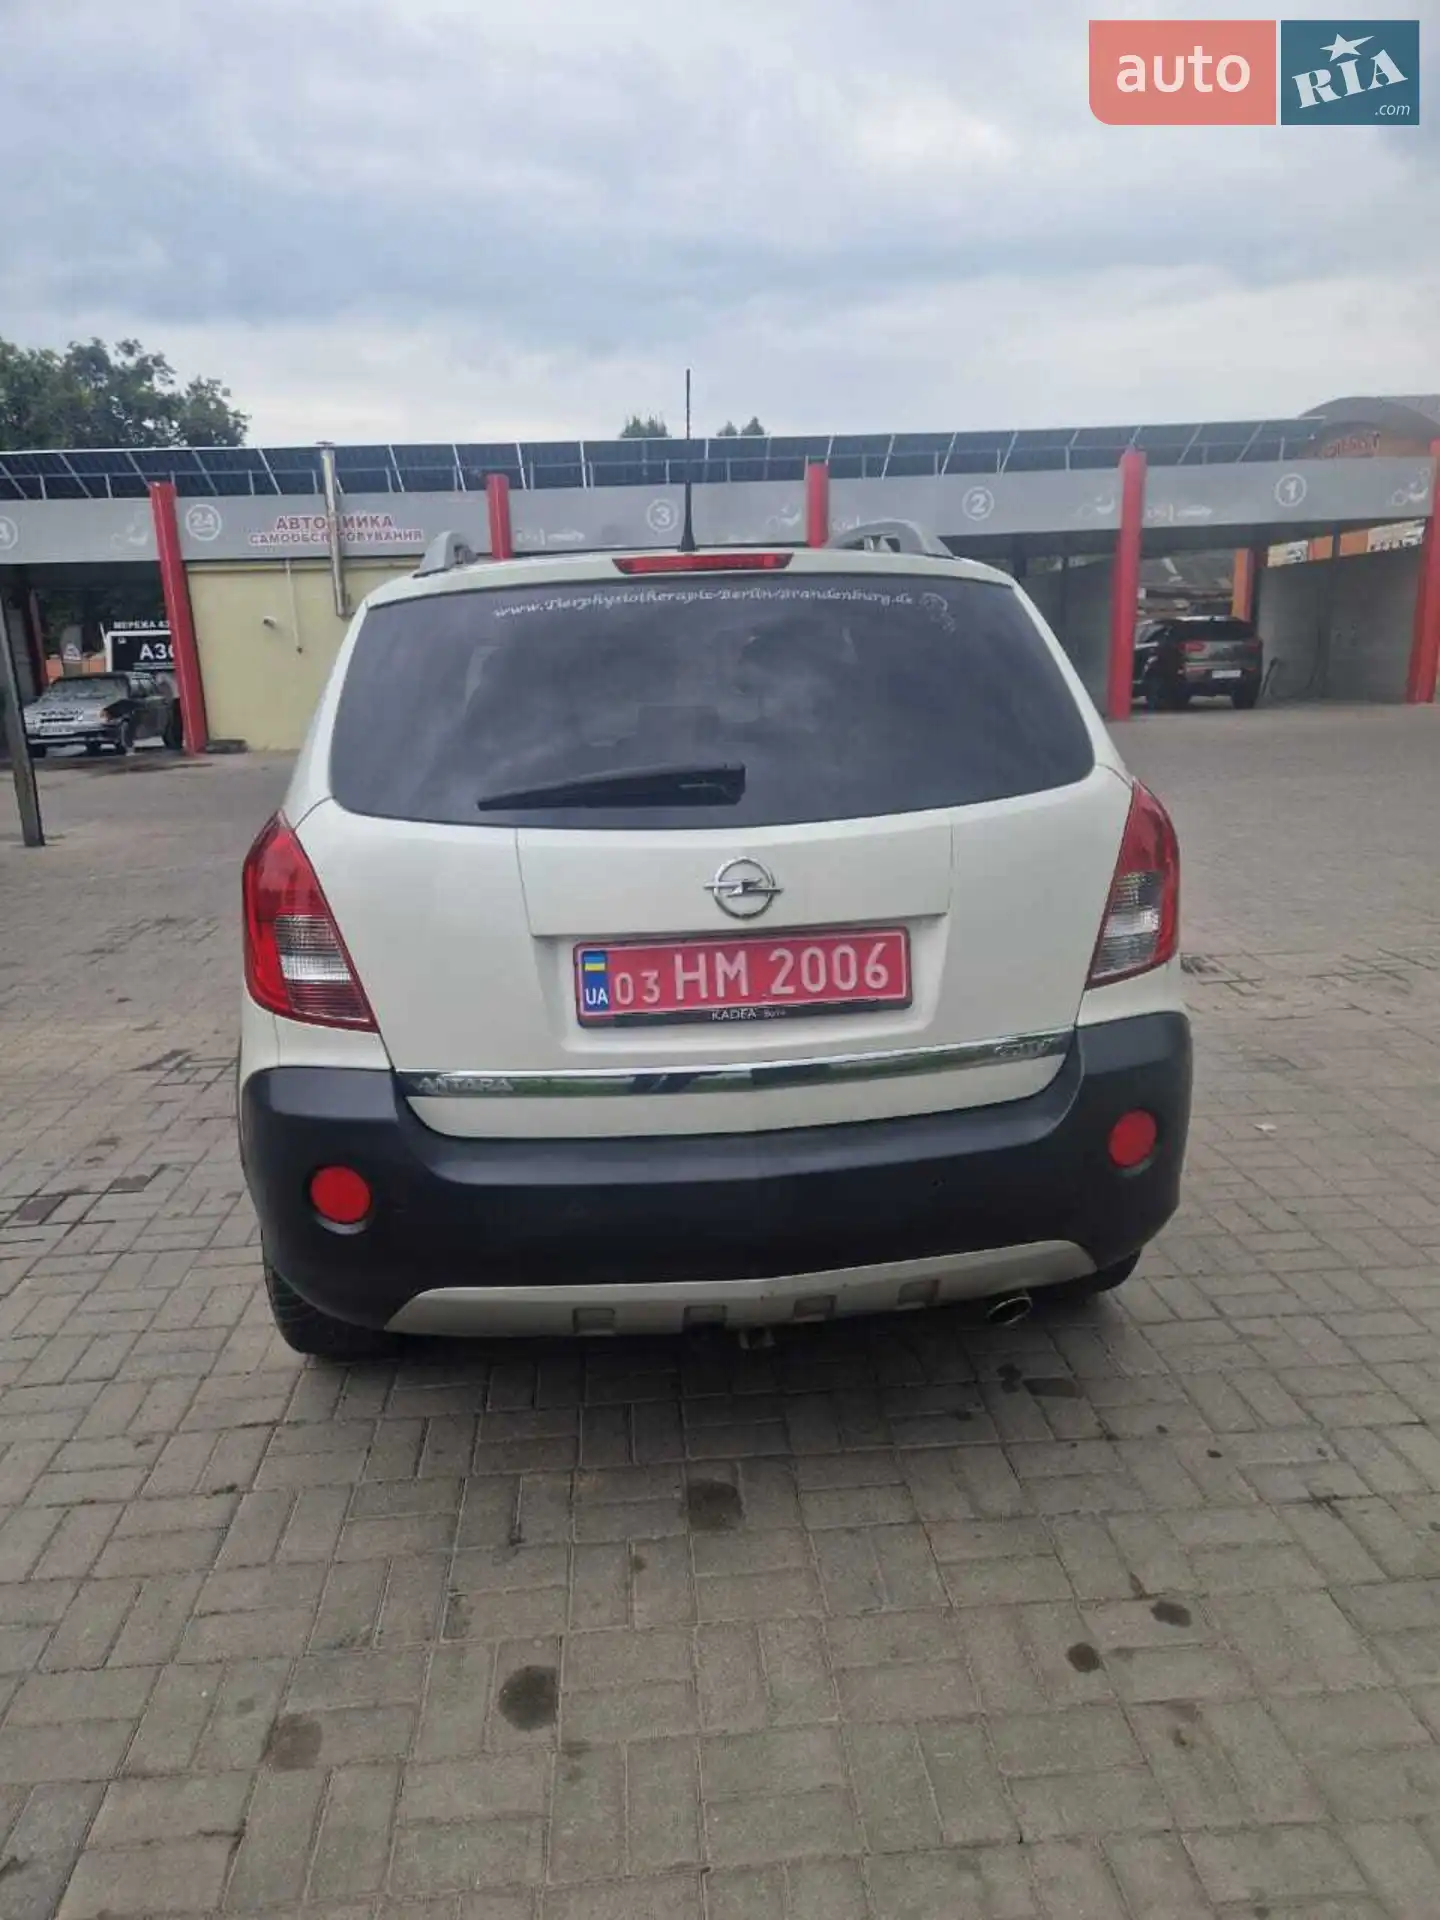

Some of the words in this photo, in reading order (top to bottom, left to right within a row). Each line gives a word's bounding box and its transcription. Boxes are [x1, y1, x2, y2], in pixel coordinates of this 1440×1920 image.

[1285, 480, 1298, 501] 1
[970, 493, 987, 514] 2
[275, 513, 393, 531] АВТОИЙКА
[655, 506, 671, 526] 3
[614, 970, 661, 1006] 03
[674, 950, 749, 1000] HM
[768, 942, 890, 996] 2006
[585, 987, 608, 1006] UA
